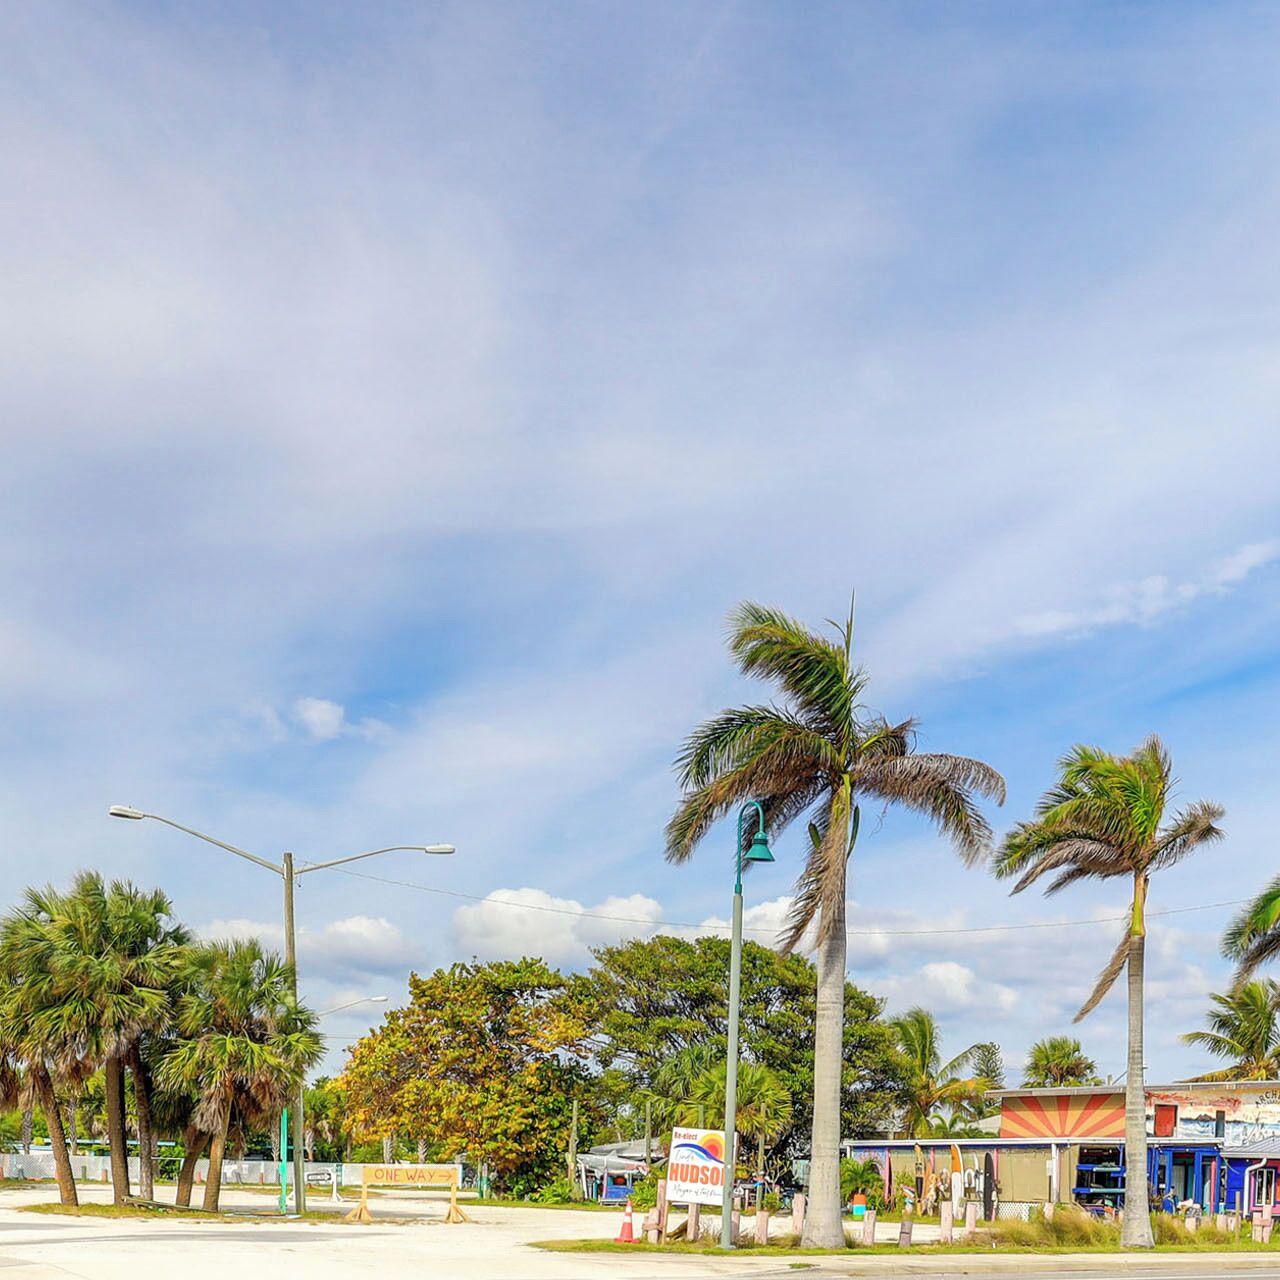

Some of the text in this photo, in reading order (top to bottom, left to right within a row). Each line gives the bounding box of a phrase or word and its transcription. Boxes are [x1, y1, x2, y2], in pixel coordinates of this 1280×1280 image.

[674, 1131, 698, 1141] Re-elect
[374, 1168, 435, 1183] ONE WAY
